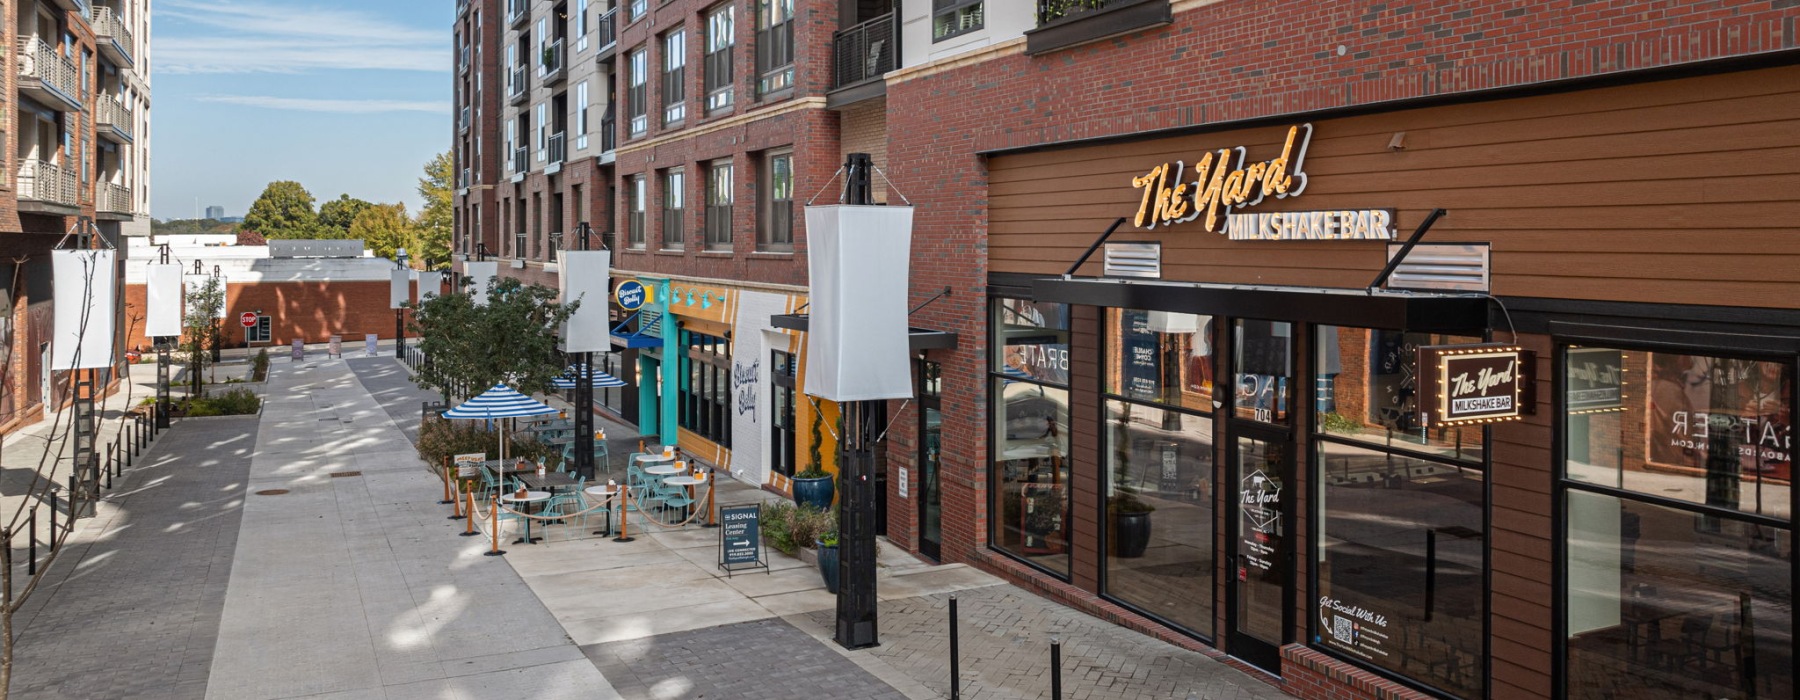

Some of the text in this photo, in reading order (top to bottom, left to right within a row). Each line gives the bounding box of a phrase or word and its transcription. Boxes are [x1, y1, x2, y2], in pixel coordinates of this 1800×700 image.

[1132, 125, 1305, 232] The Yard
[1229, 210, 1391, 240] MILKSHAKE BAR
[618, 286, 641, 298] Biscuit
[624, 295, 640, 305] Belly
[1451, 361, 1514, 397] The Yard
[1454, 397, 1511, 412] MILKSHAKE BAR
[1255, 408, 1271, 423] 704
[1240, 488, 1280, 508] The Yard
[1320, 596, 1388, 627] Get Social With Us
